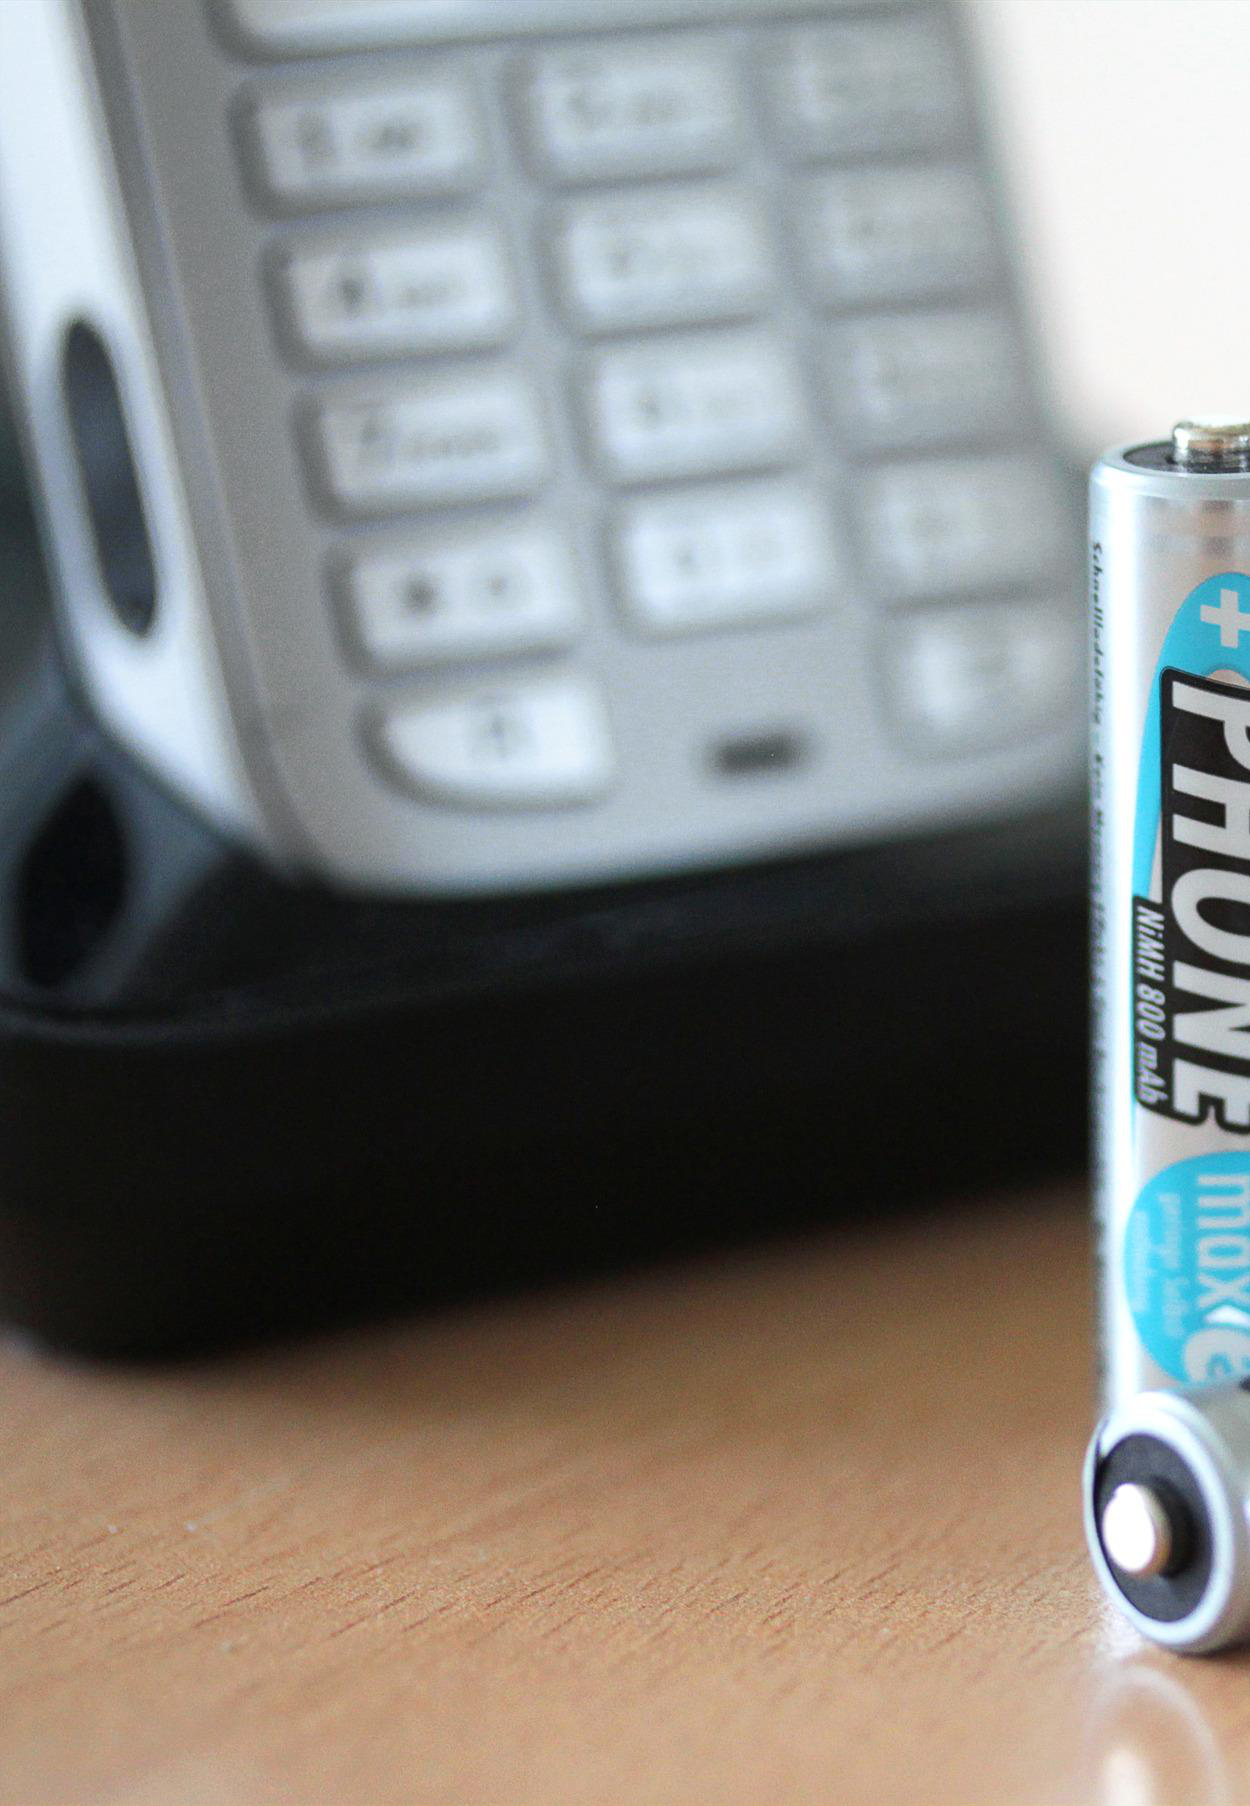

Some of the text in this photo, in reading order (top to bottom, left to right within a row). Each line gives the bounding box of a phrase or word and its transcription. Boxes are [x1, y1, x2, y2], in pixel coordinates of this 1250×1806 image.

[1136, 904, 1168, 1105] NiMH 800 mAh
